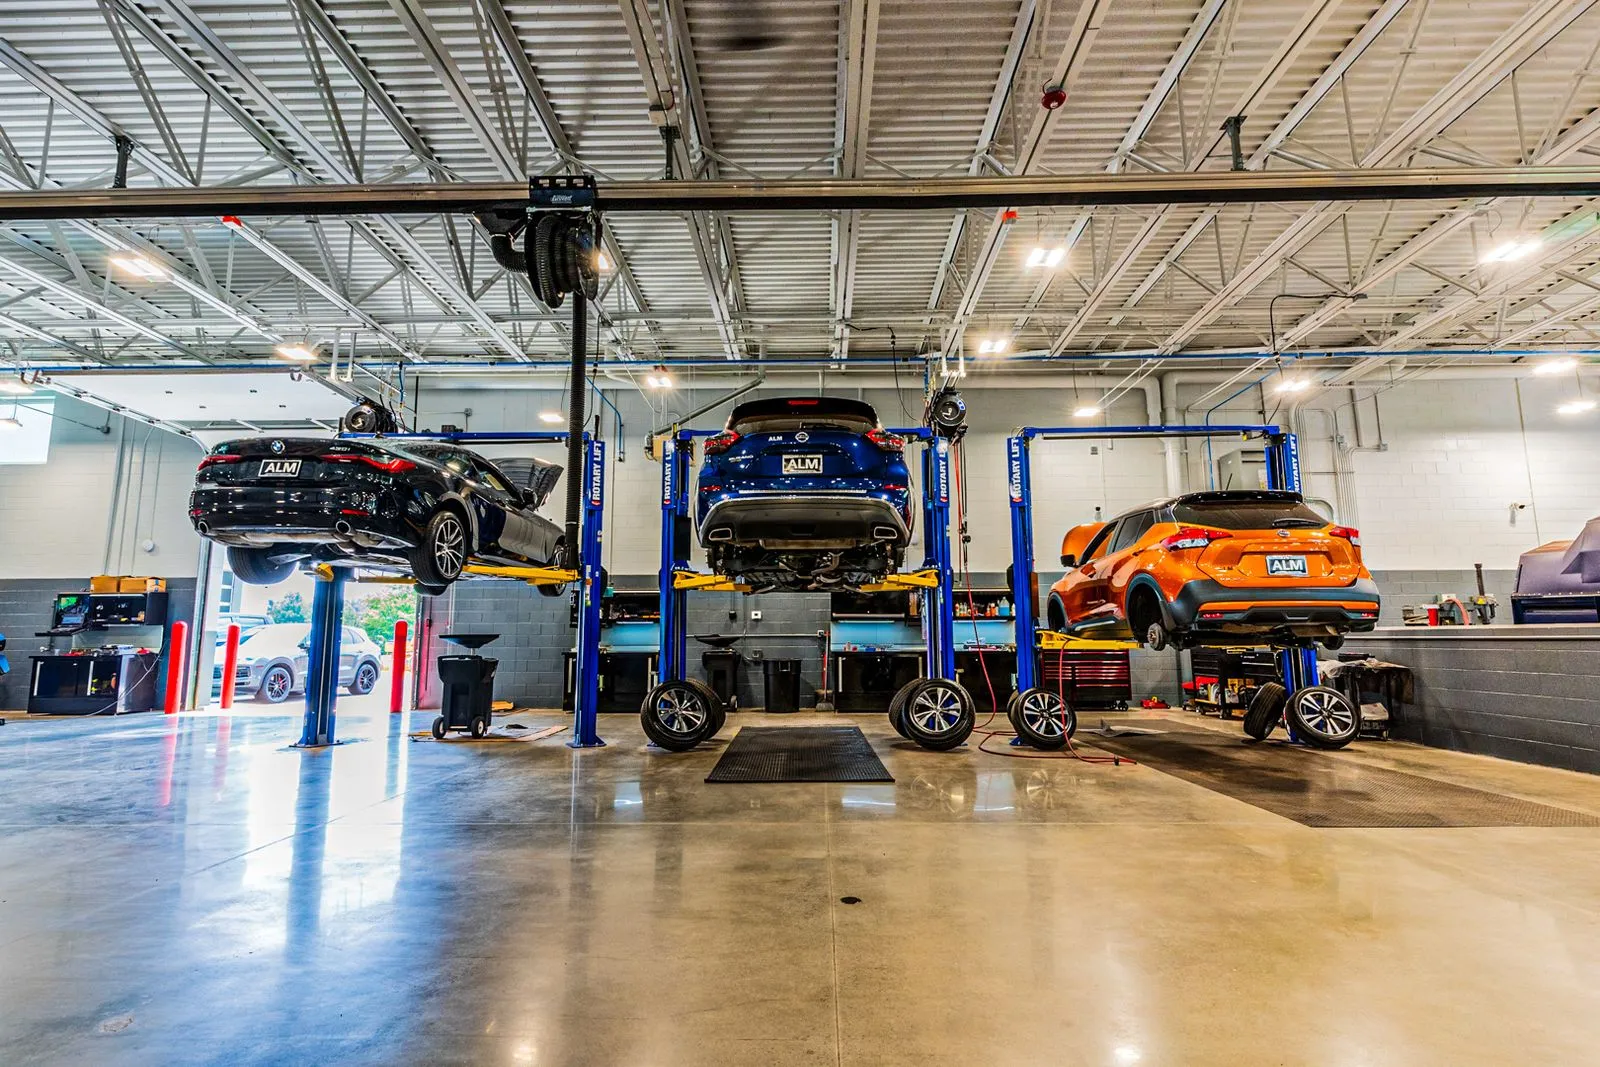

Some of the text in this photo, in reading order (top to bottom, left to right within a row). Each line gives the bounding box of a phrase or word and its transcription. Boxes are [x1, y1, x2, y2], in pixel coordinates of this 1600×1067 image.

[1011, 438, 1020, 458] LIFT
[264, 462, 298, 473] ALM
[592, 441, 602, 501] ROTARY LIFT
[787, 458, 819, 469] ALM
[664, 462, 672, 500] ROTARY
[939, 459, 948, 498] ROTARY
[1272, 560, 1304, 571] ALM
